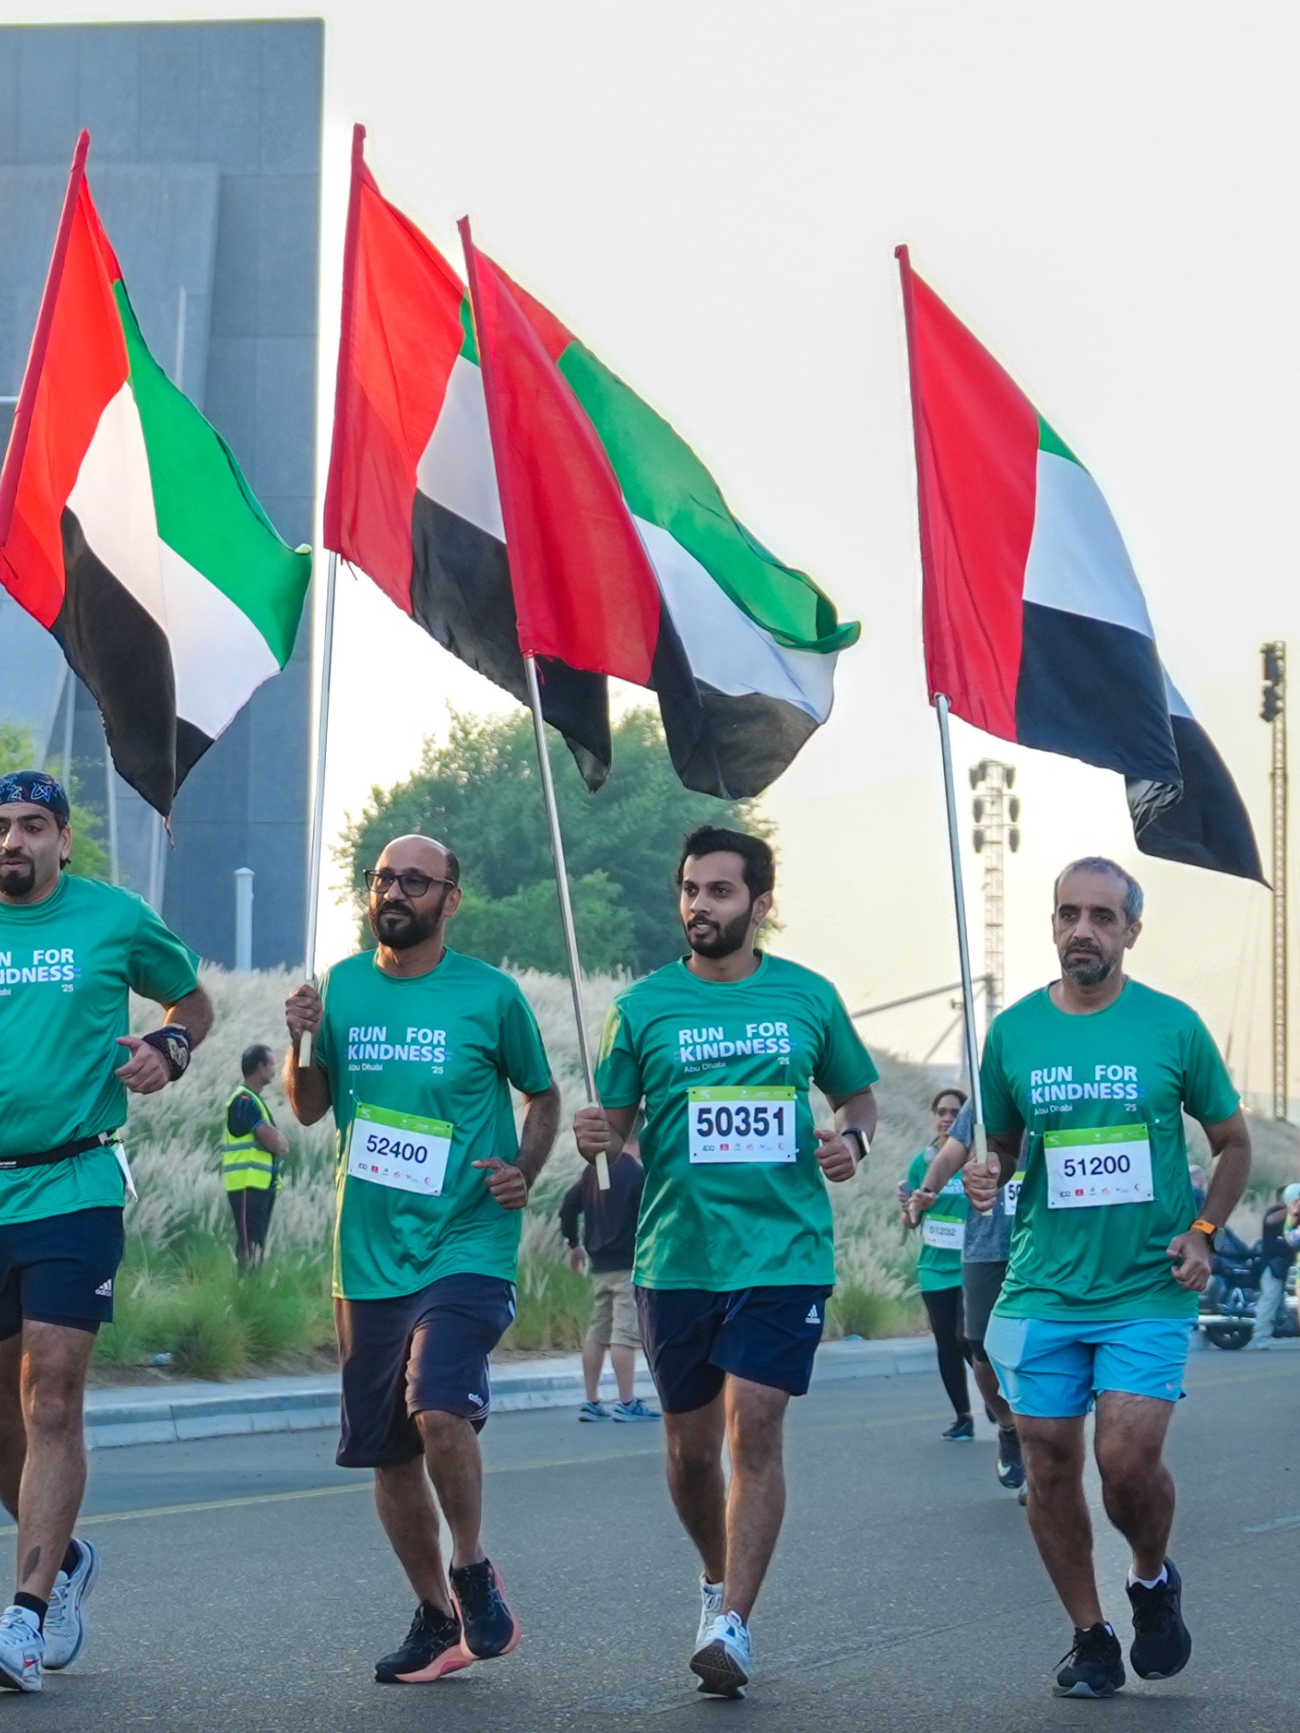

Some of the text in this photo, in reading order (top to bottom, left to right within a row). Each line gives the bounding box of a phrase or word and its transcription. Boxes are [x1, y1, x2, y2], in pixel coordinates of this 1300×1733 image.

[33, 948, 74, 965] FOR
[348, 1026, 446, 1046] RUN FOR
[679, 1021, 790, 1045] RUN FOR
[347, 1043, 445, 1063] KINDNESS
[679, 1038, 791, 1063] KINDNESS
[684, 1064, 700, 1073] Abu
[1030, 1064, 1138, 1086] RUN FOR
[1031, 1082, 1139, 1104] KINDNESS
[1034, 1103, 1073, 1116] Abu Dhabi
[696, 1106, 784, 1137] 50351
[366, 1134, 428, 1163] 52400
[1064, 1154, 1130, 1177] 51200
